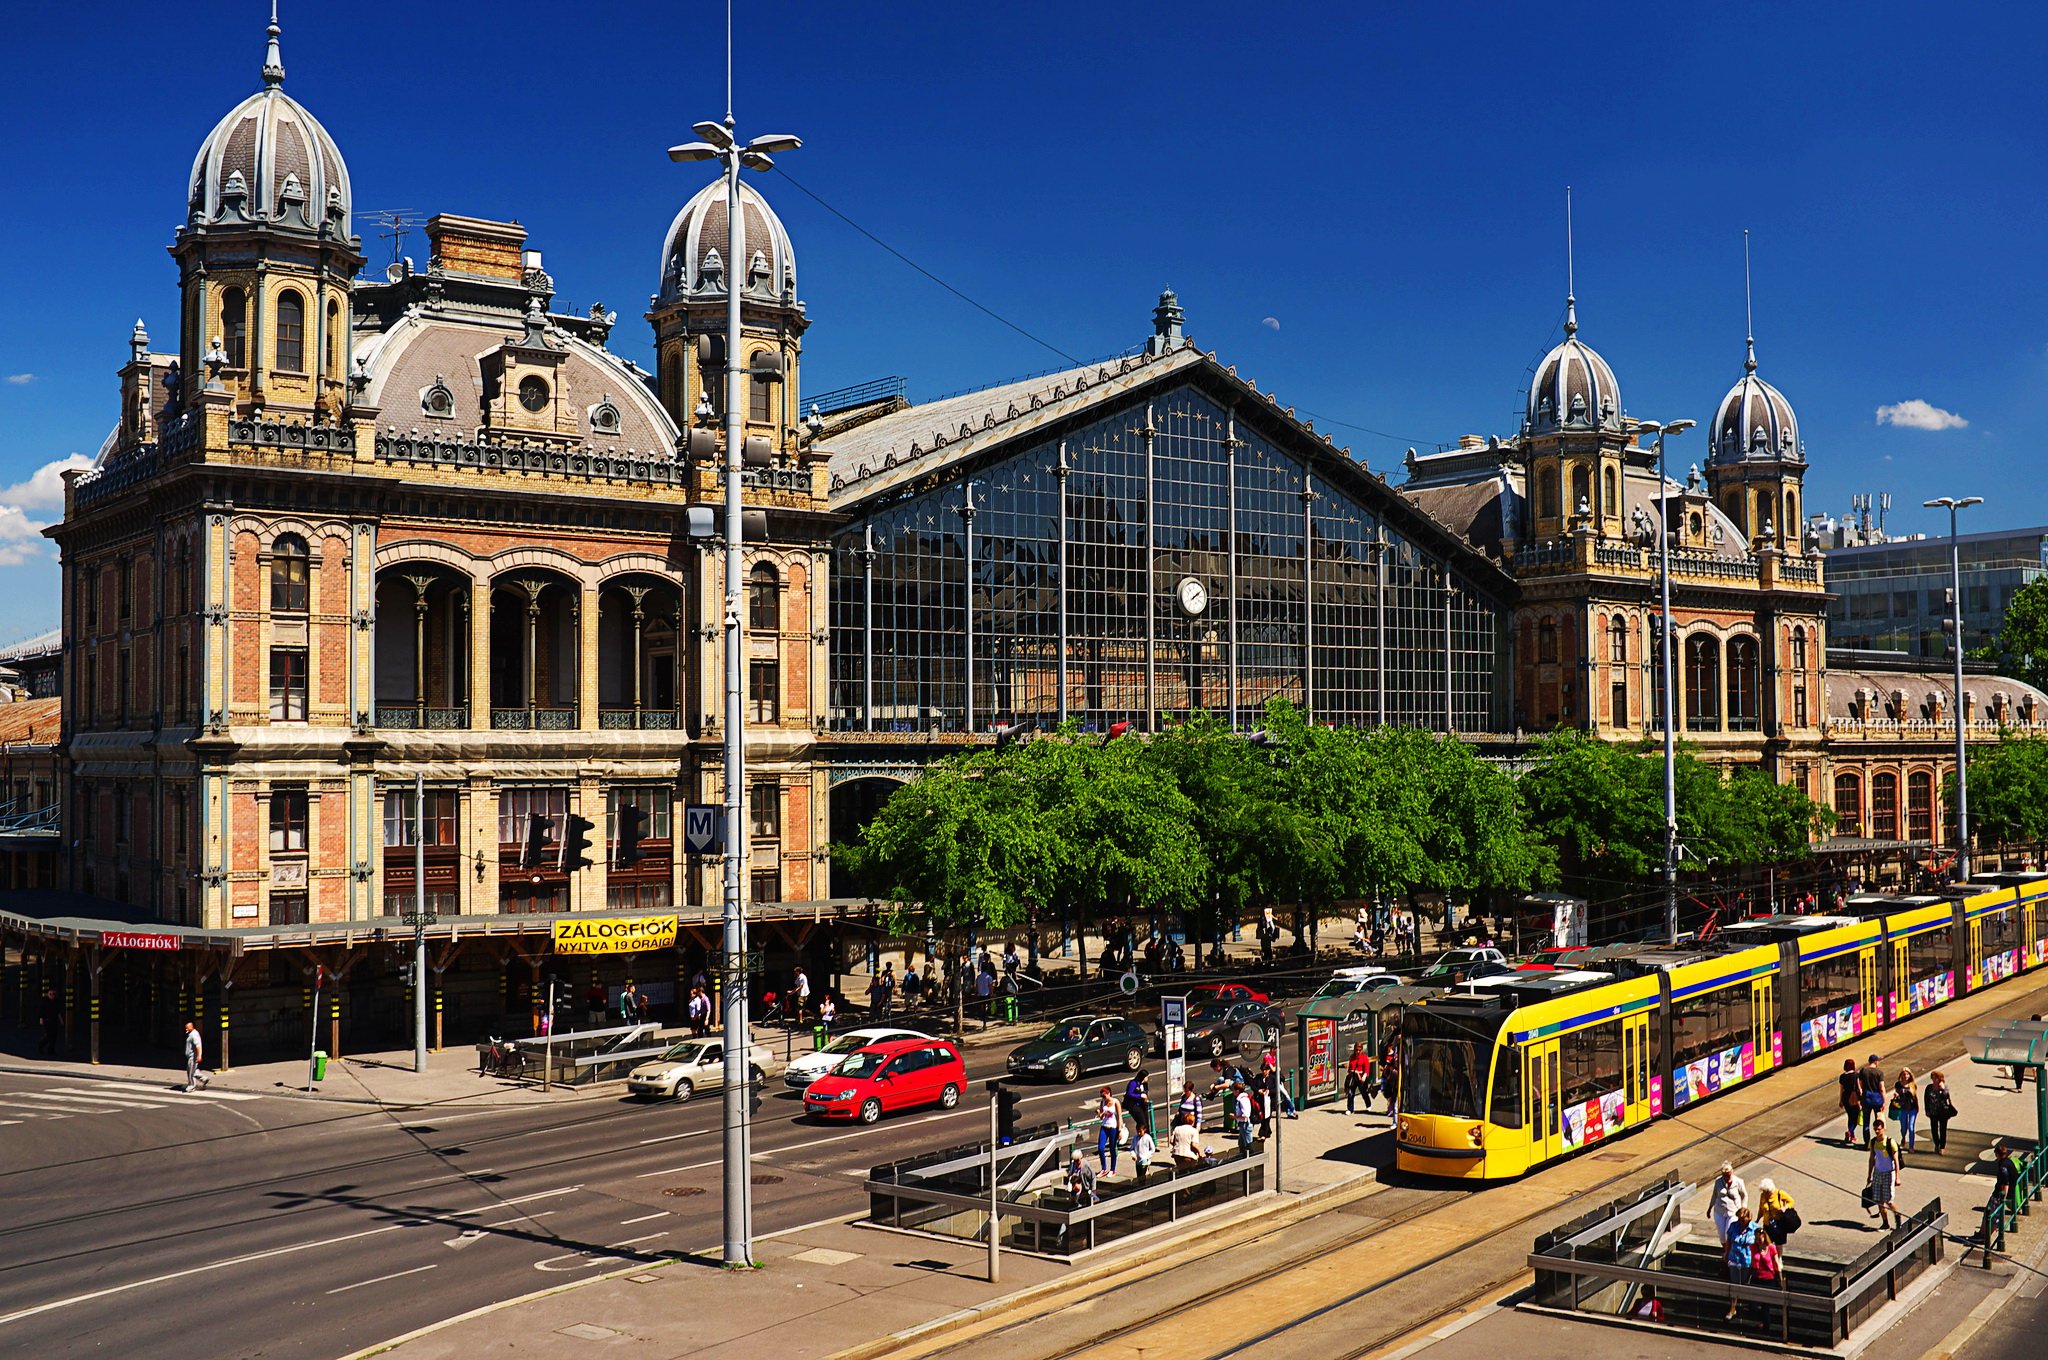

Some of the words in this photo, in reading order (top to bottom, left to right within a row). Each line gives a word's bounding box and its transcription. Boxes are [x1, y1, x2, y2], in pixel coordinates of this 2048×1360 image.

[689, 811, 712, 835] M
[558, 920, 674, 939] ZÁLOGFIÓK
[108, 934, 171, 949] ZÁLOGFIÓK
[558, 941, 609, 952] NYITVA
[613, 940, 628, 950] 19
[631, 937, 675, 950] ÓRÁIG!
[1409, 1134, 1427, 1145] 2040
